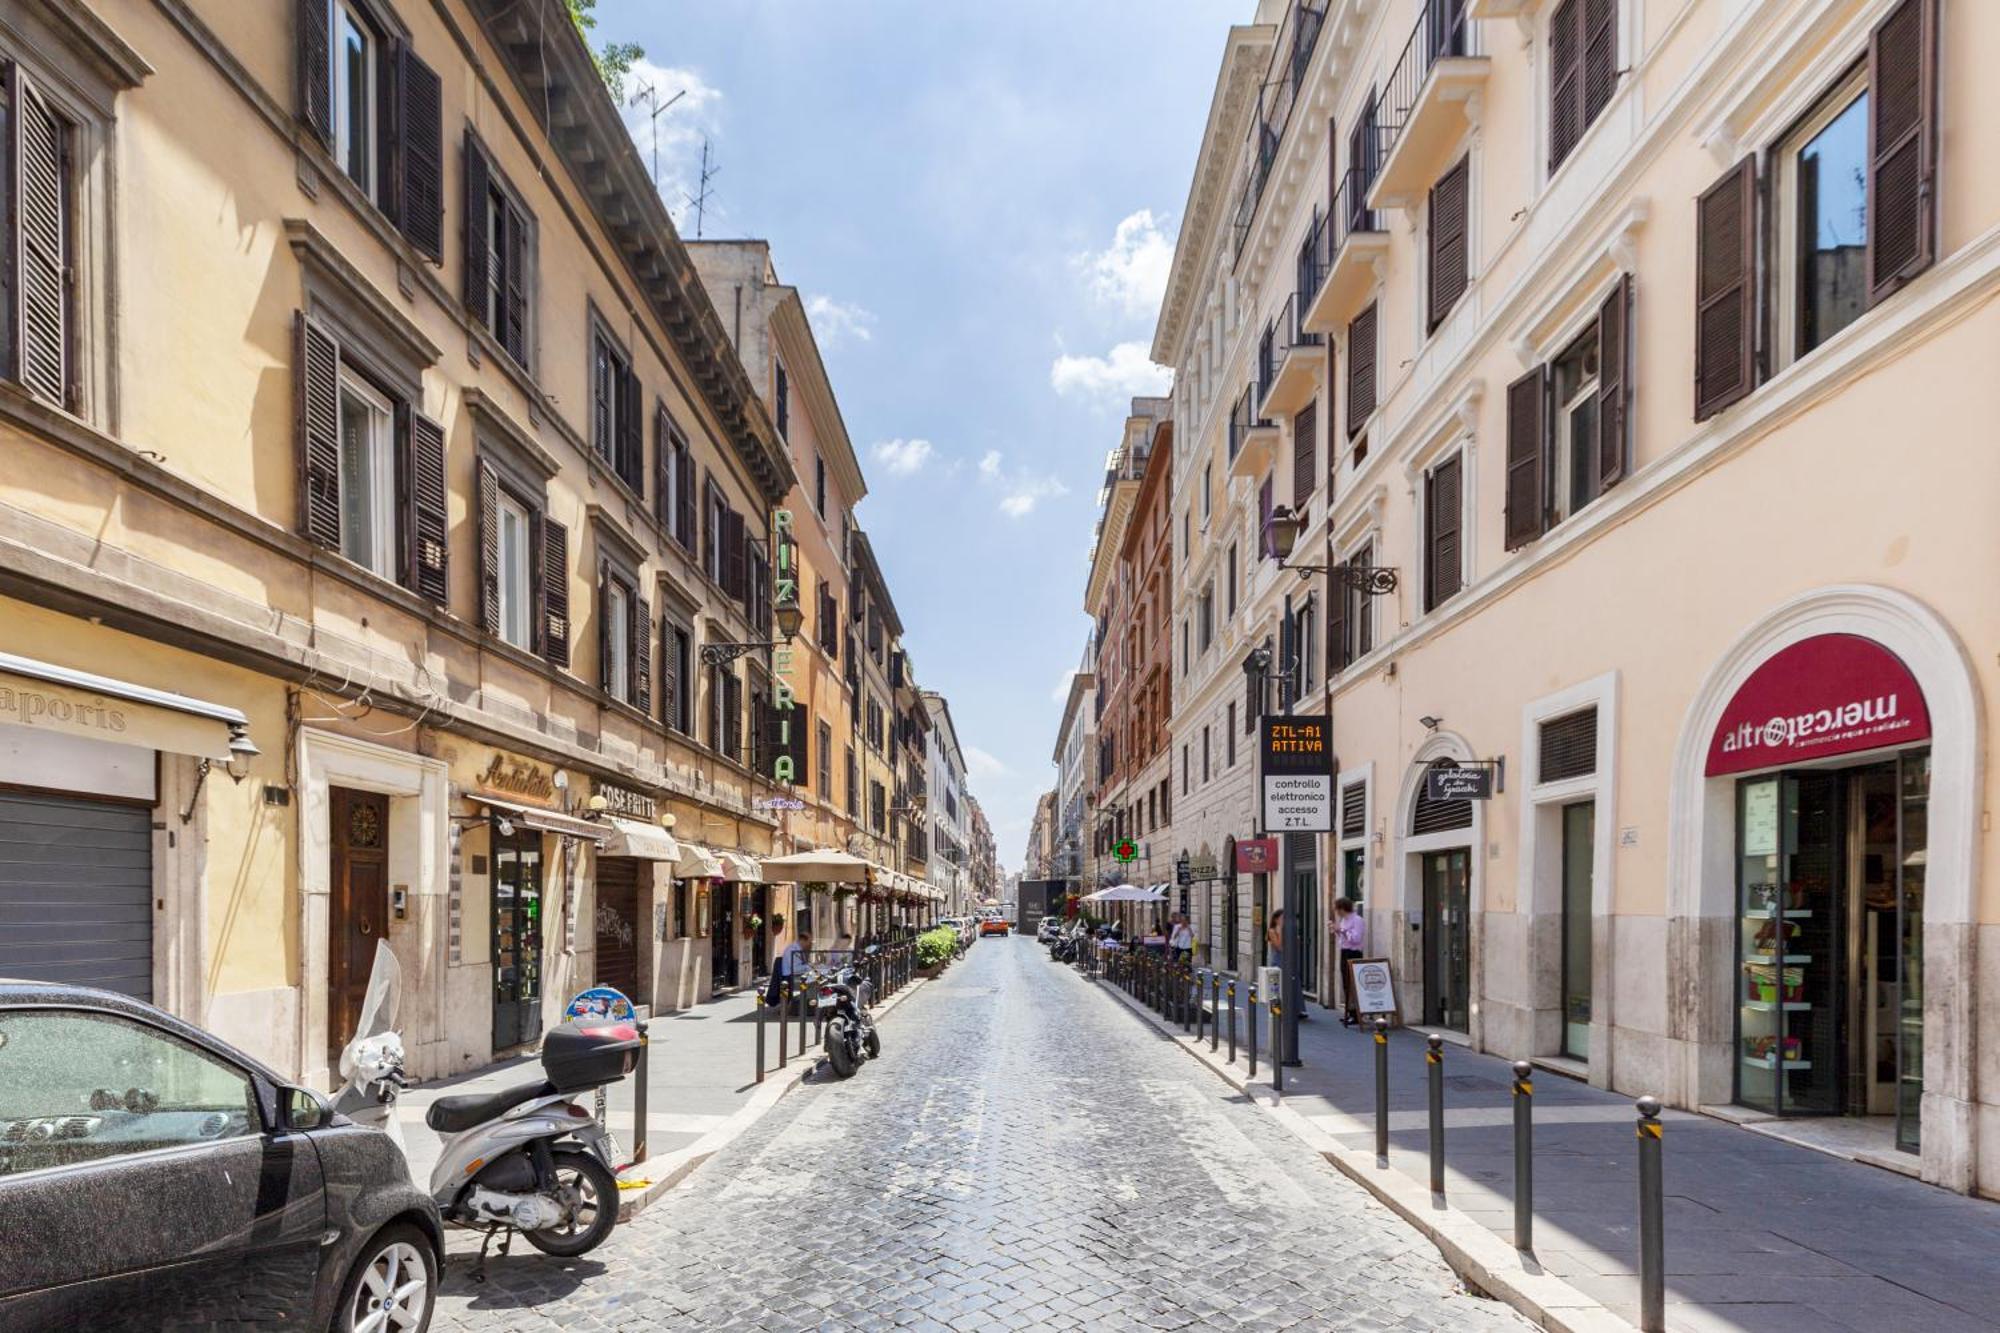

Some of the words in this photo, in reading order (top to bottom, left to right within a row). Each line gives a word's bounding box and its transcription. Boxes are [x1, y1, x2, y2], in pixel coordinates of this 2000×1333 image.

[775, 510, 795, 782] PIZERIA
[1271, 725, 1321, 738] ZTL-A1
[1272, 740, 1323, 752] ATTIVA
[1275, 779, 1321, 789] controllo
[1270, 791, 1325, 801] elettronico
[1278, 805, 1318, 814] accesso
[1284, 817, 1312, 827] Z.T.L.
[1191, 865, 1217, 874] PIZZA
